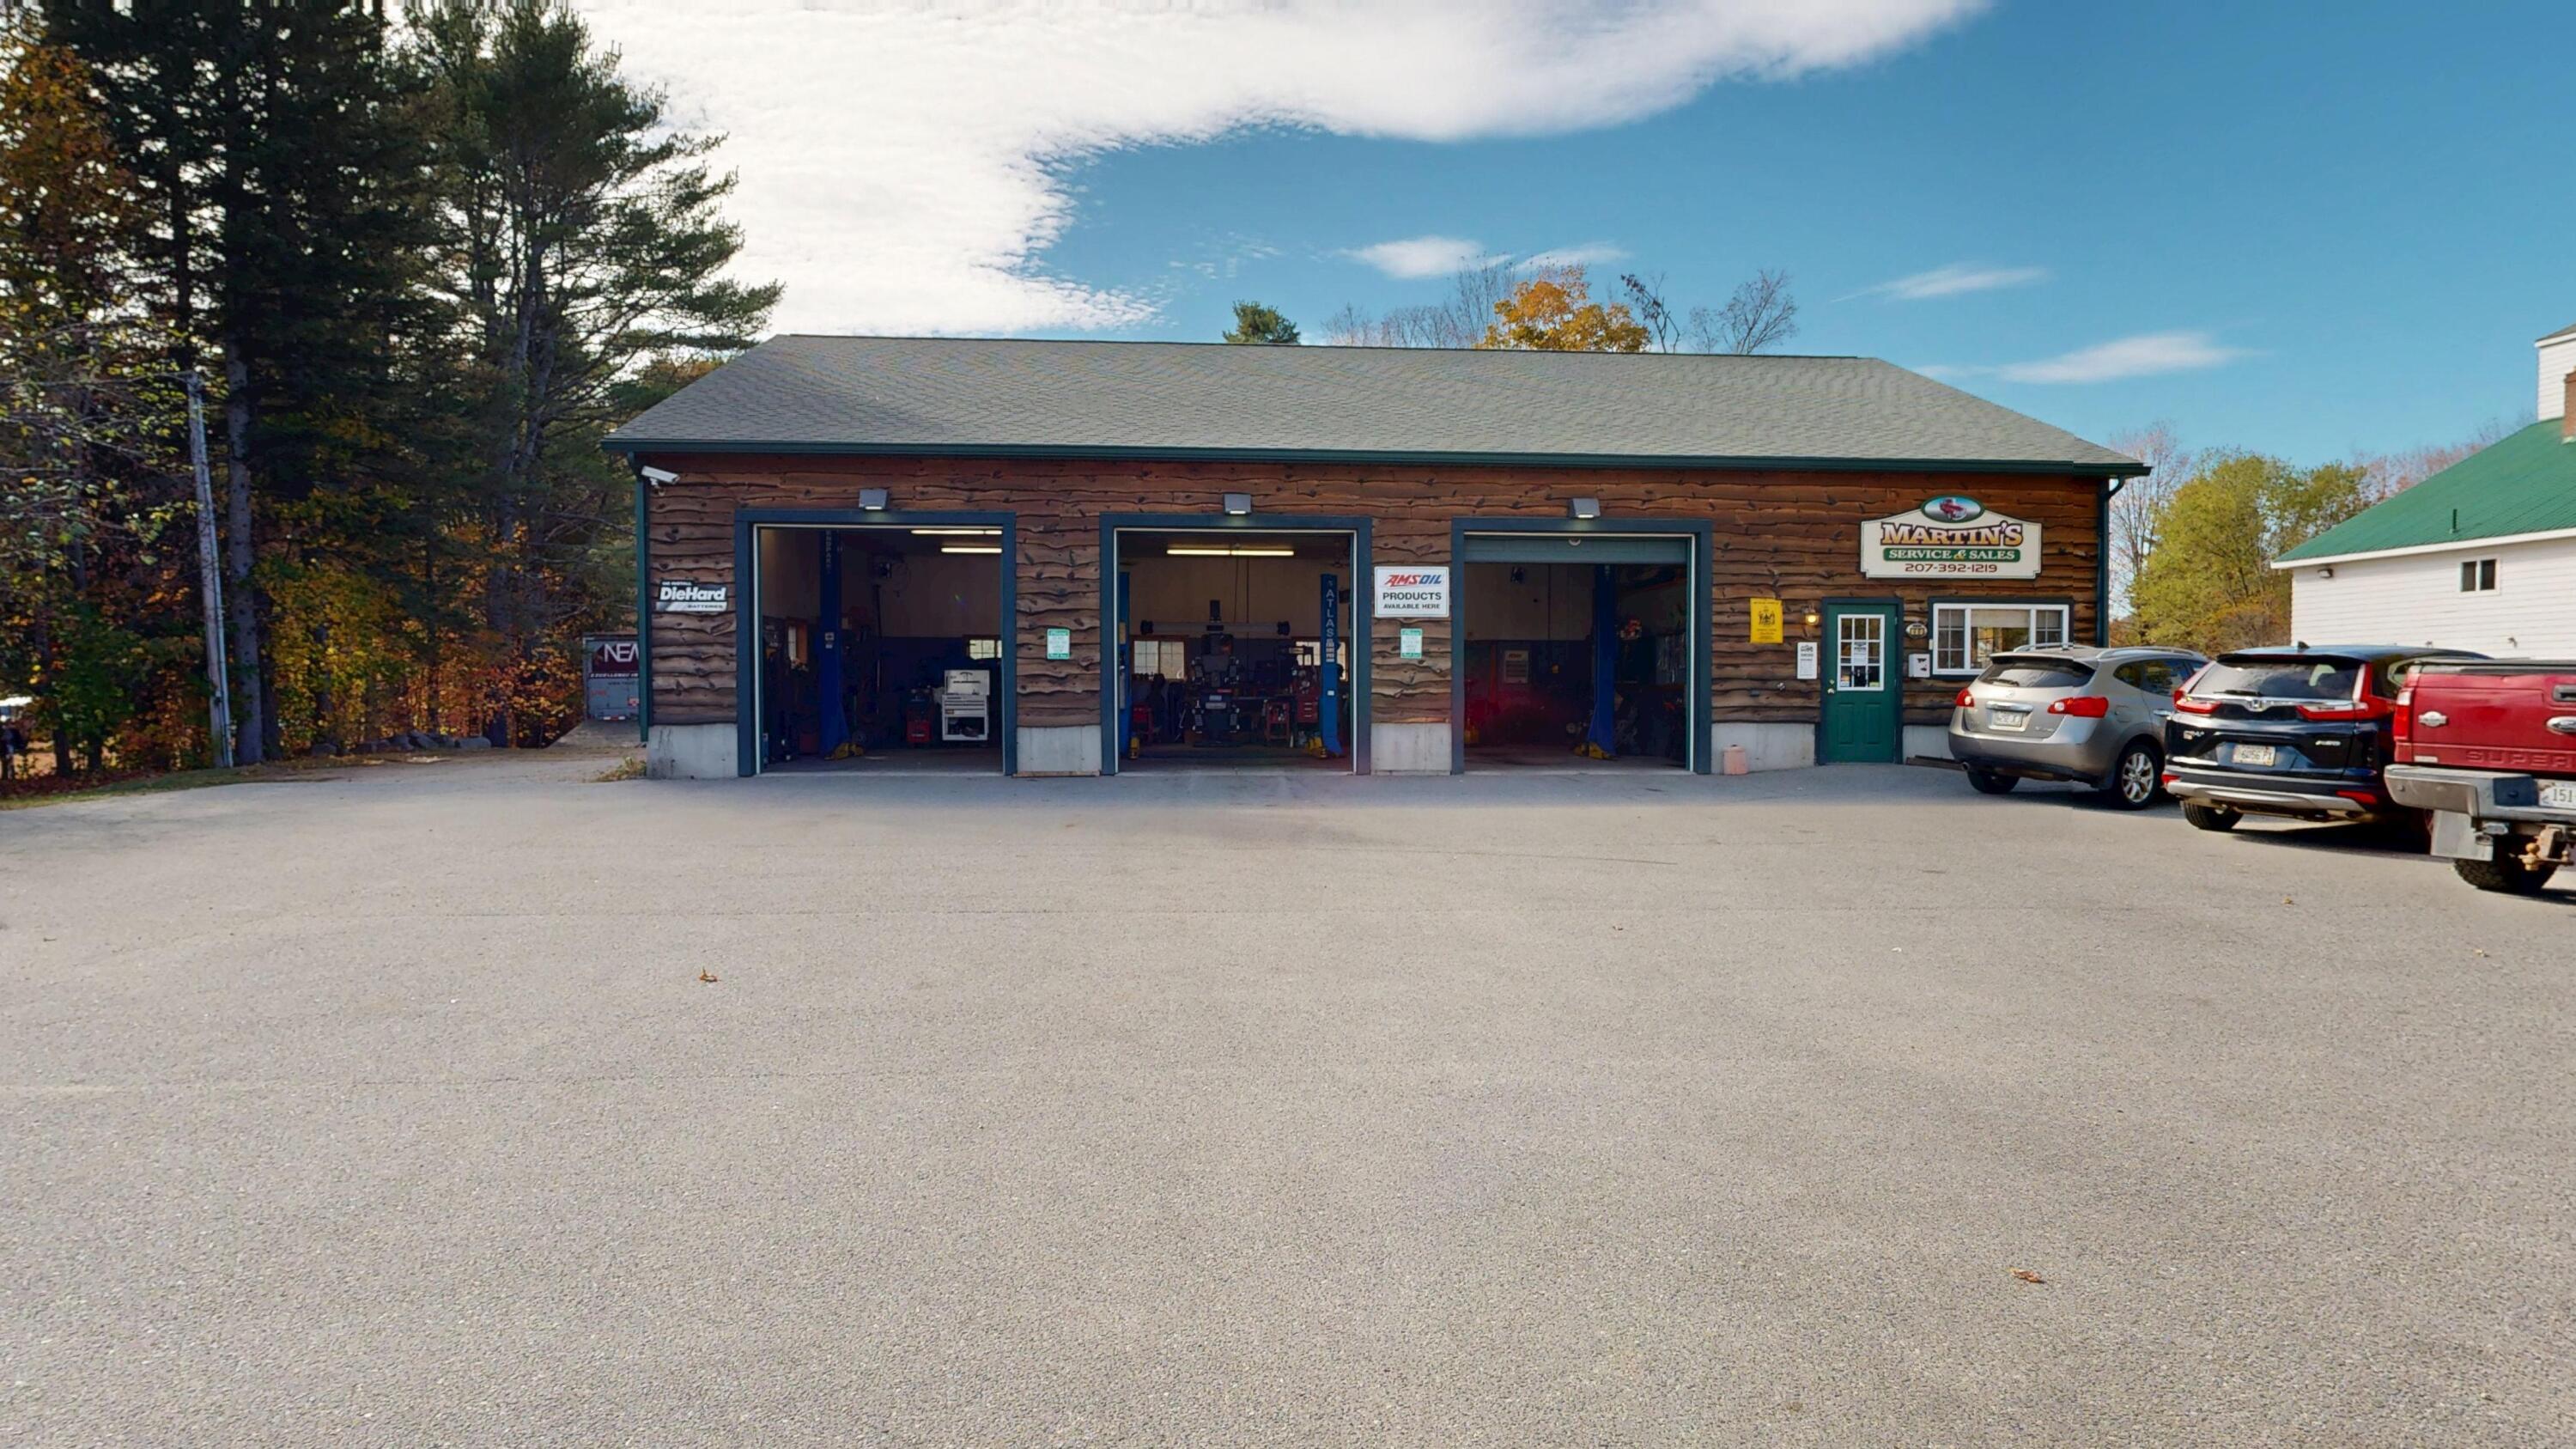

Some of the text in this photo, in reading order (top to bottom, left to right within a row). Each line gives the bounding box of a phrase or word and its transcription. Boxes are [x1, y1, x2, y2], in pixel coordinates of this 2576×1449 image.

[1880, 521, 2023, 546] MARTIN'S
[1889, 550, 2015, 560] SERVICE & SALES
[1905, 563, 1998, 573] 207-392-1219
[1384, 574, 1443, 588] AMSOIL
[660, 587, 726, 600] DieHard
[1382, 592, 1443, 600] PRODUCTS
[1326, 589, 1334, 637] ATLAS
[2467, 751, 2573, 769] SUPER
